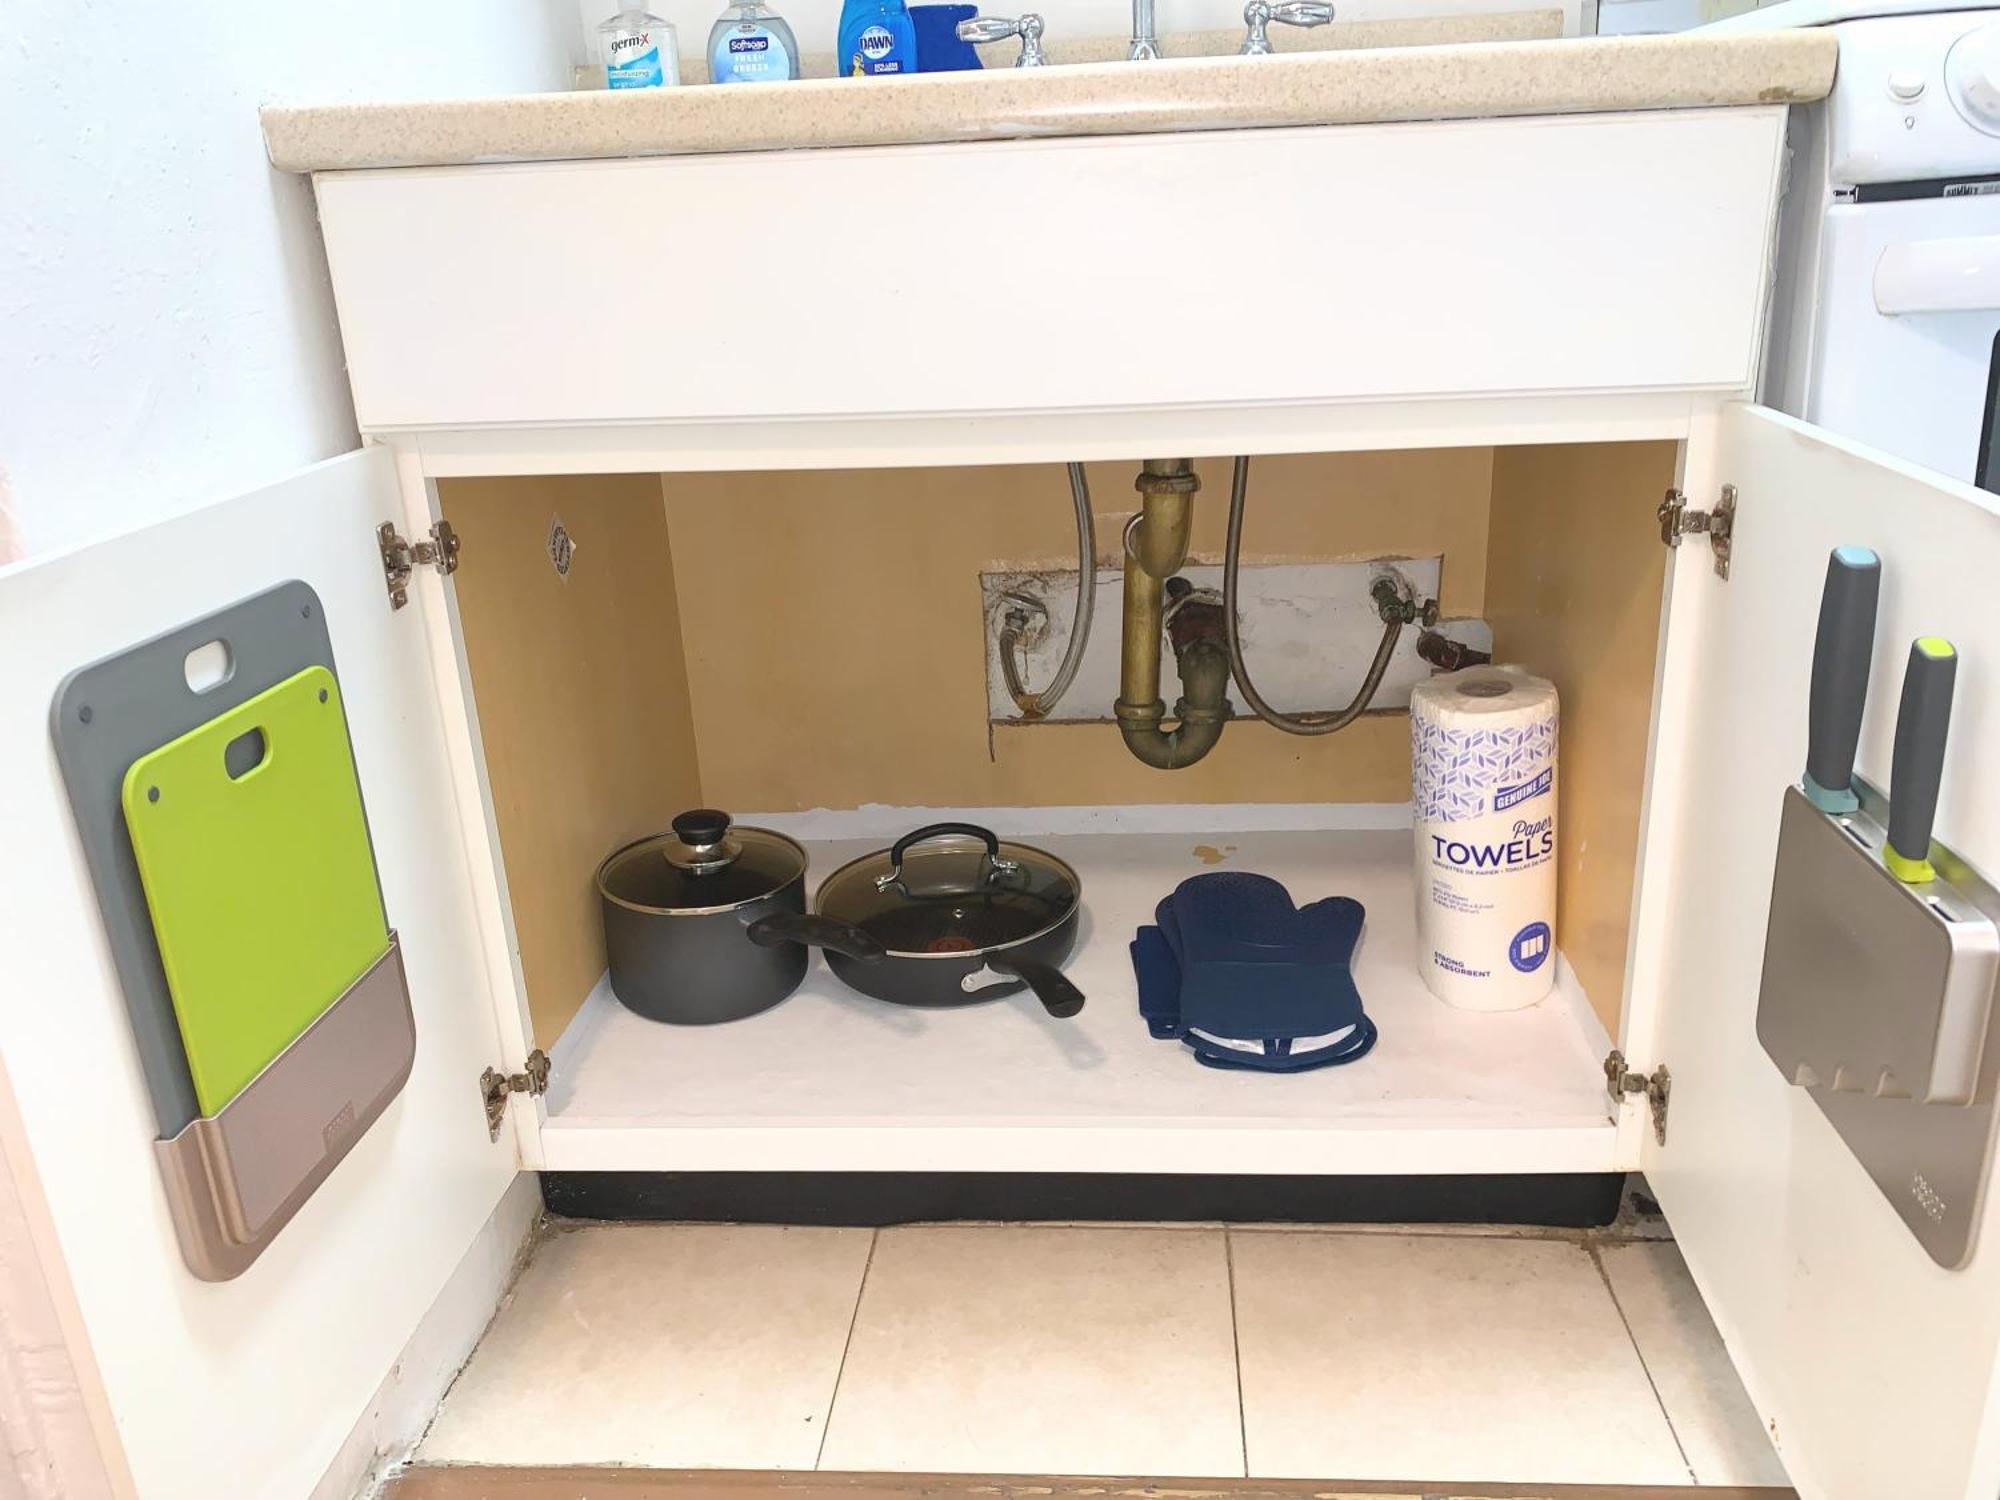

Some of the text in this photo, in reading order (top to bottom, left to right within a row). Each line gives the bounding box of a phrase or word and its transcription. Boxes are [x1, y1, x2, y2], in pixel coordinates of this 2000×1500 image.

[860, 34, 894, 50] DAWN
[1513, 816, 1552, 839] Paper
[1432, 831, 1553, 868] TOWELS
[1434, 951, 1464, 968] STRONG
[1440, 961, 1491, 978] ABSORBENT
